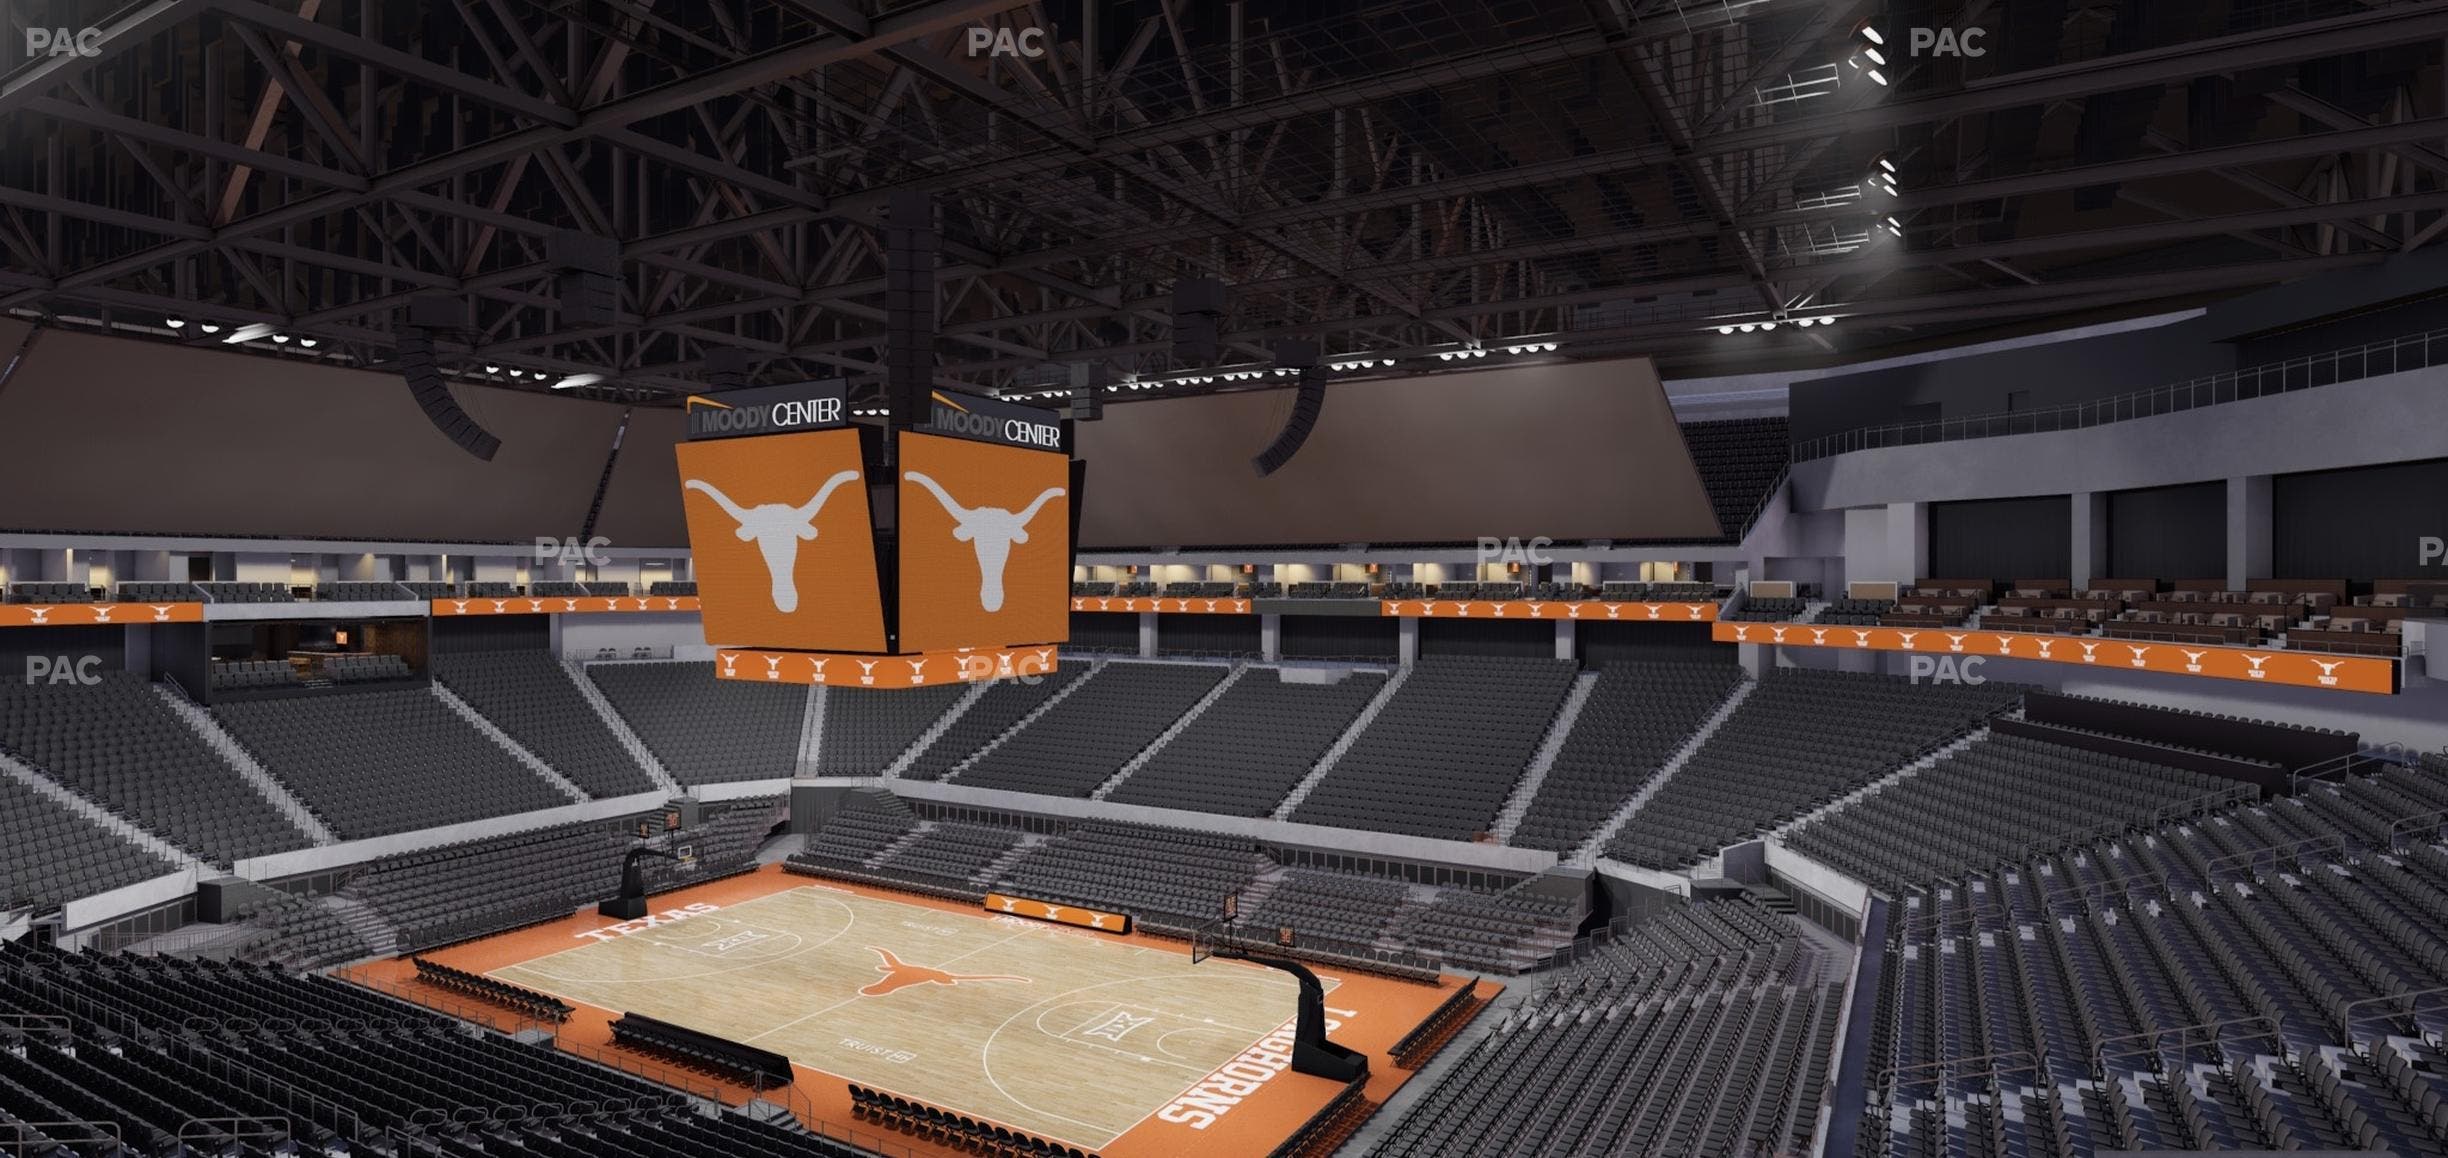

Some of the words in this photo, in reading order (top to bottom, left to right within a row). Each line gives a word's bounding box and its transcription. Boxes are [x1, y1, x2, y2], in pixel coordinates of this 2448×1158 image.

[702, 404, 770, 433] MOODY
[771, 397, 841, 427] CENTER
[937, 407, 1004, 438] MOODY
[1004, 419, 1060, 448] CENTER
[574, 902, 721, 943] TEXAS
[838, 1037, 894, 1056] TRUIST
